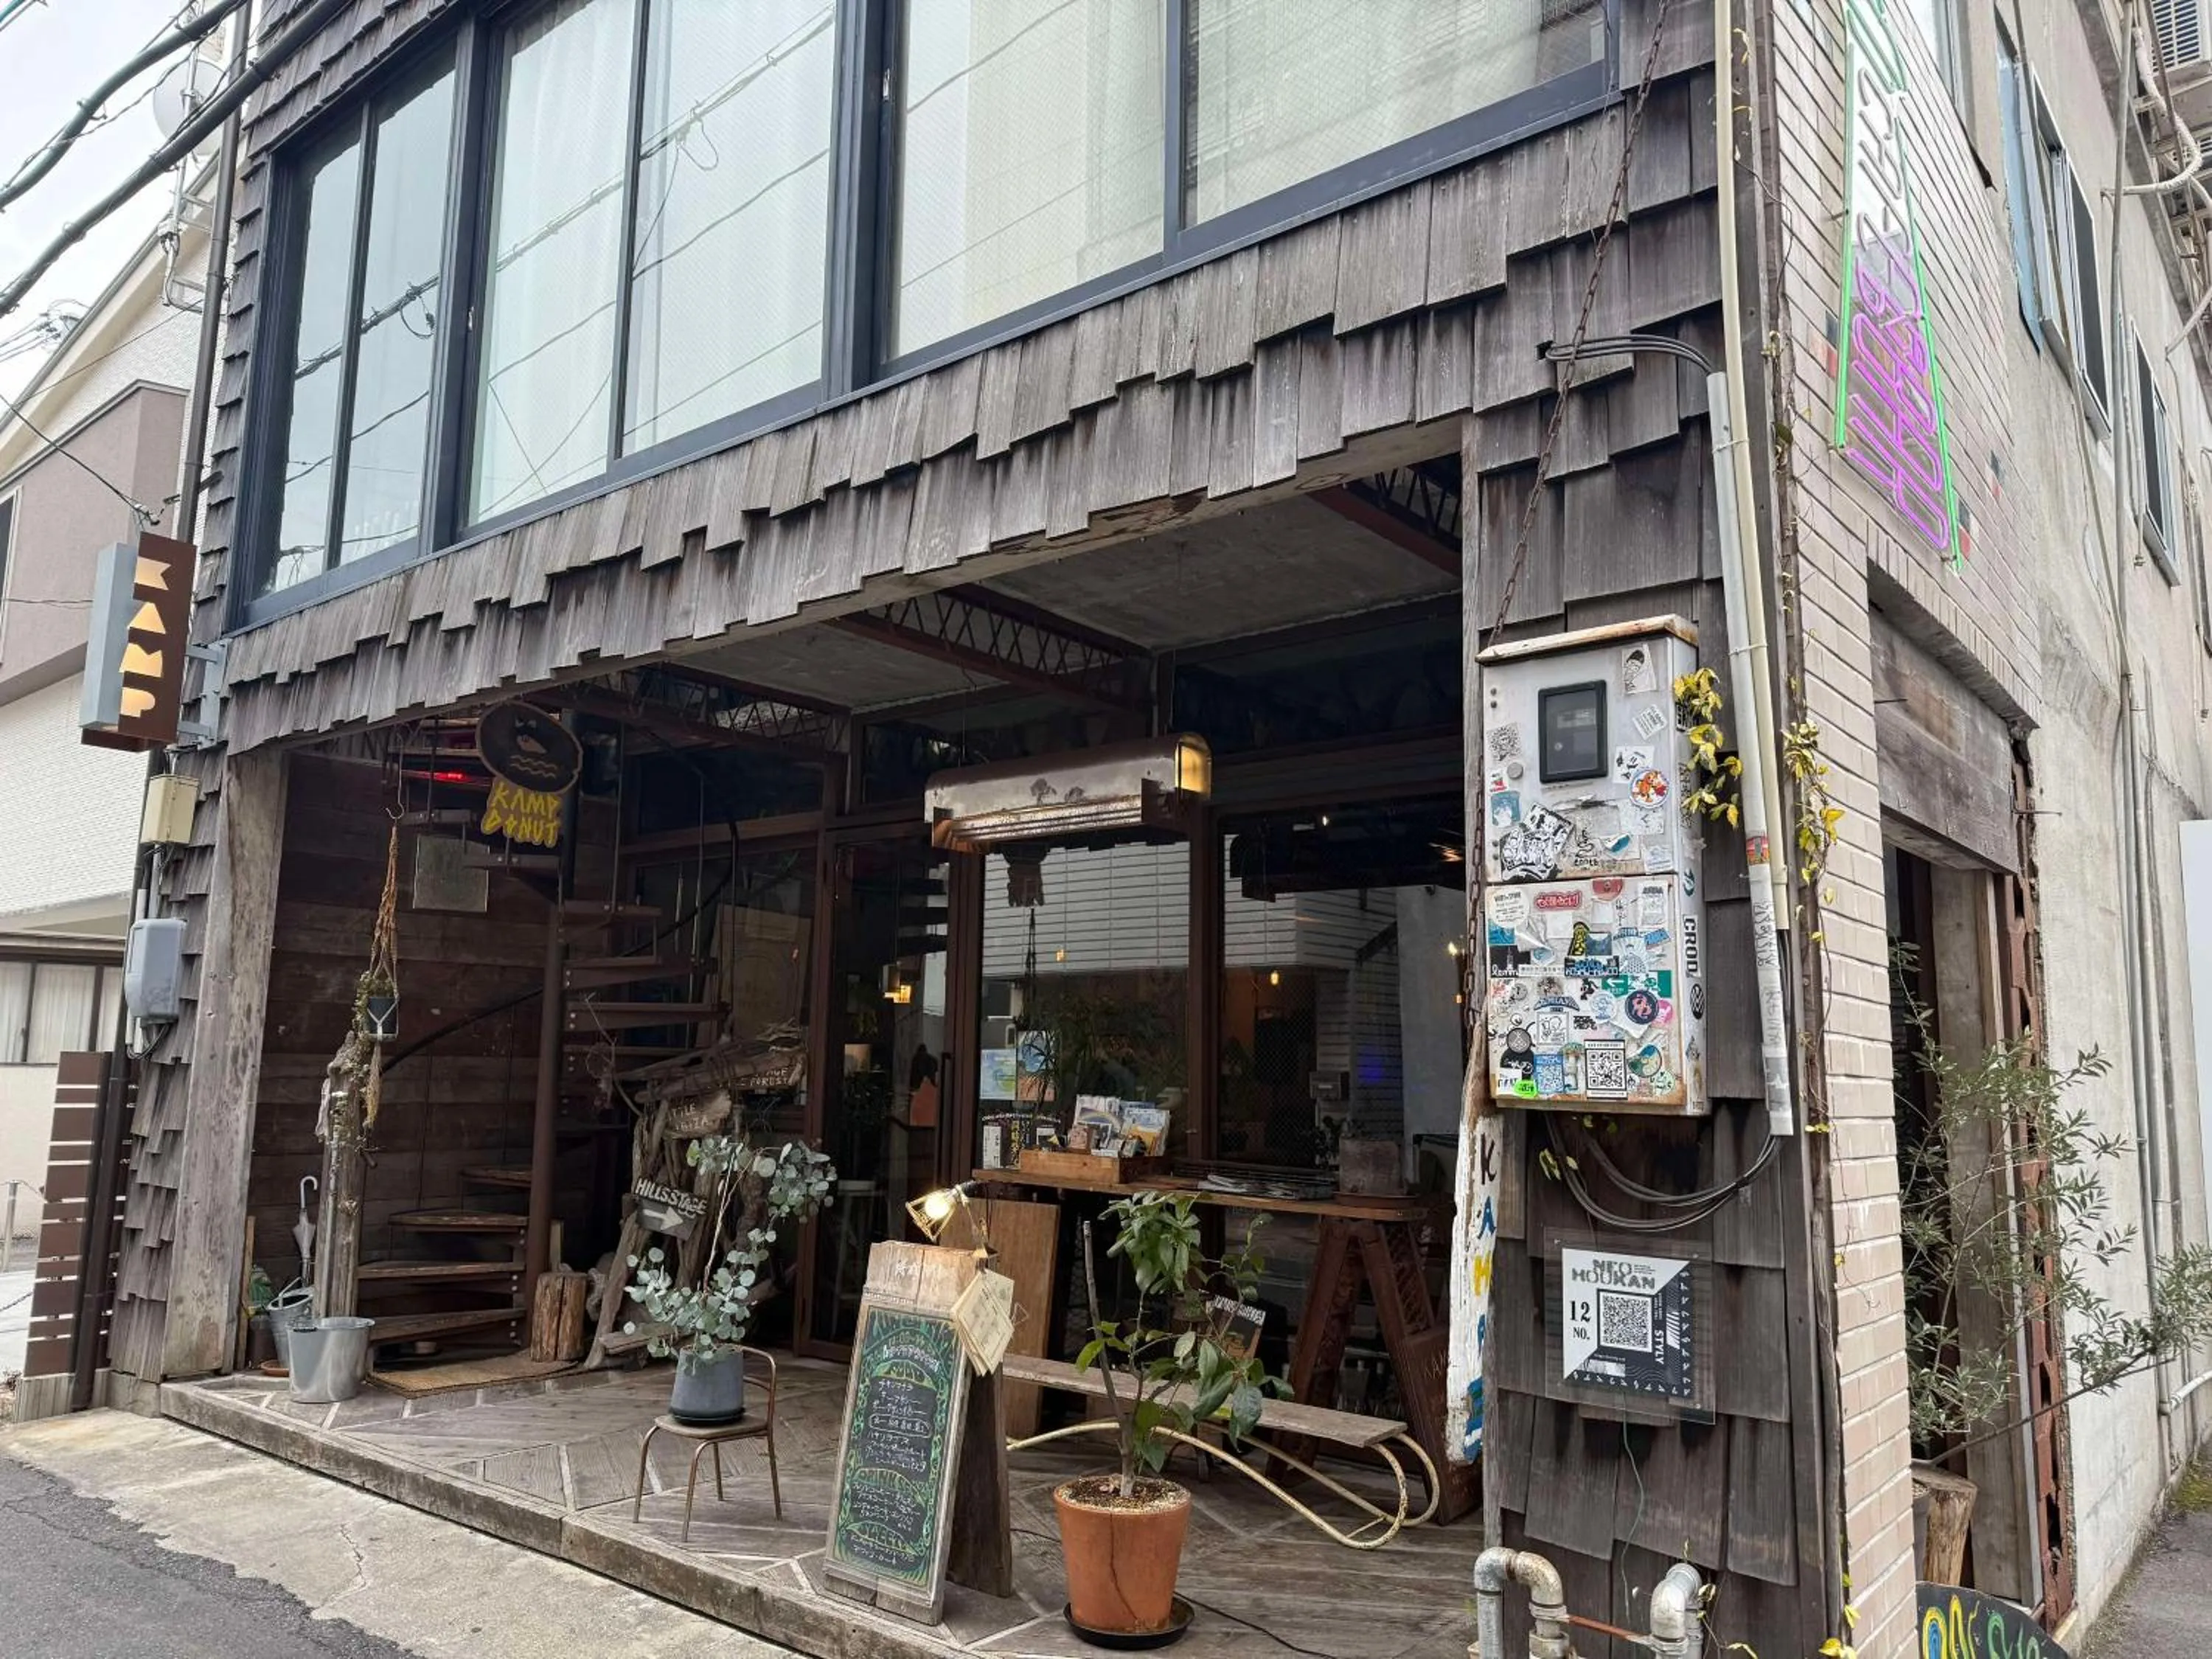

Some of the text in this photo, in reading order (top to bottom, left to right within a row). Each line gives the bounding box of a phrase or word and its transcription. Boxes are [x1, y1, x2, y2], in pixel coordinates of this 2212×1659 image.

[119, 557, 171, 717] KAMP
[491, 782, 562, 818] KAMP
[1571, 1267, 1655, 1289] HOUKAN
[1593, 1259, 1632, 1275] NEO
[1570, 1301, 1590, 1323] 12
[1654, 1330, 1664, 1365] STYLY
